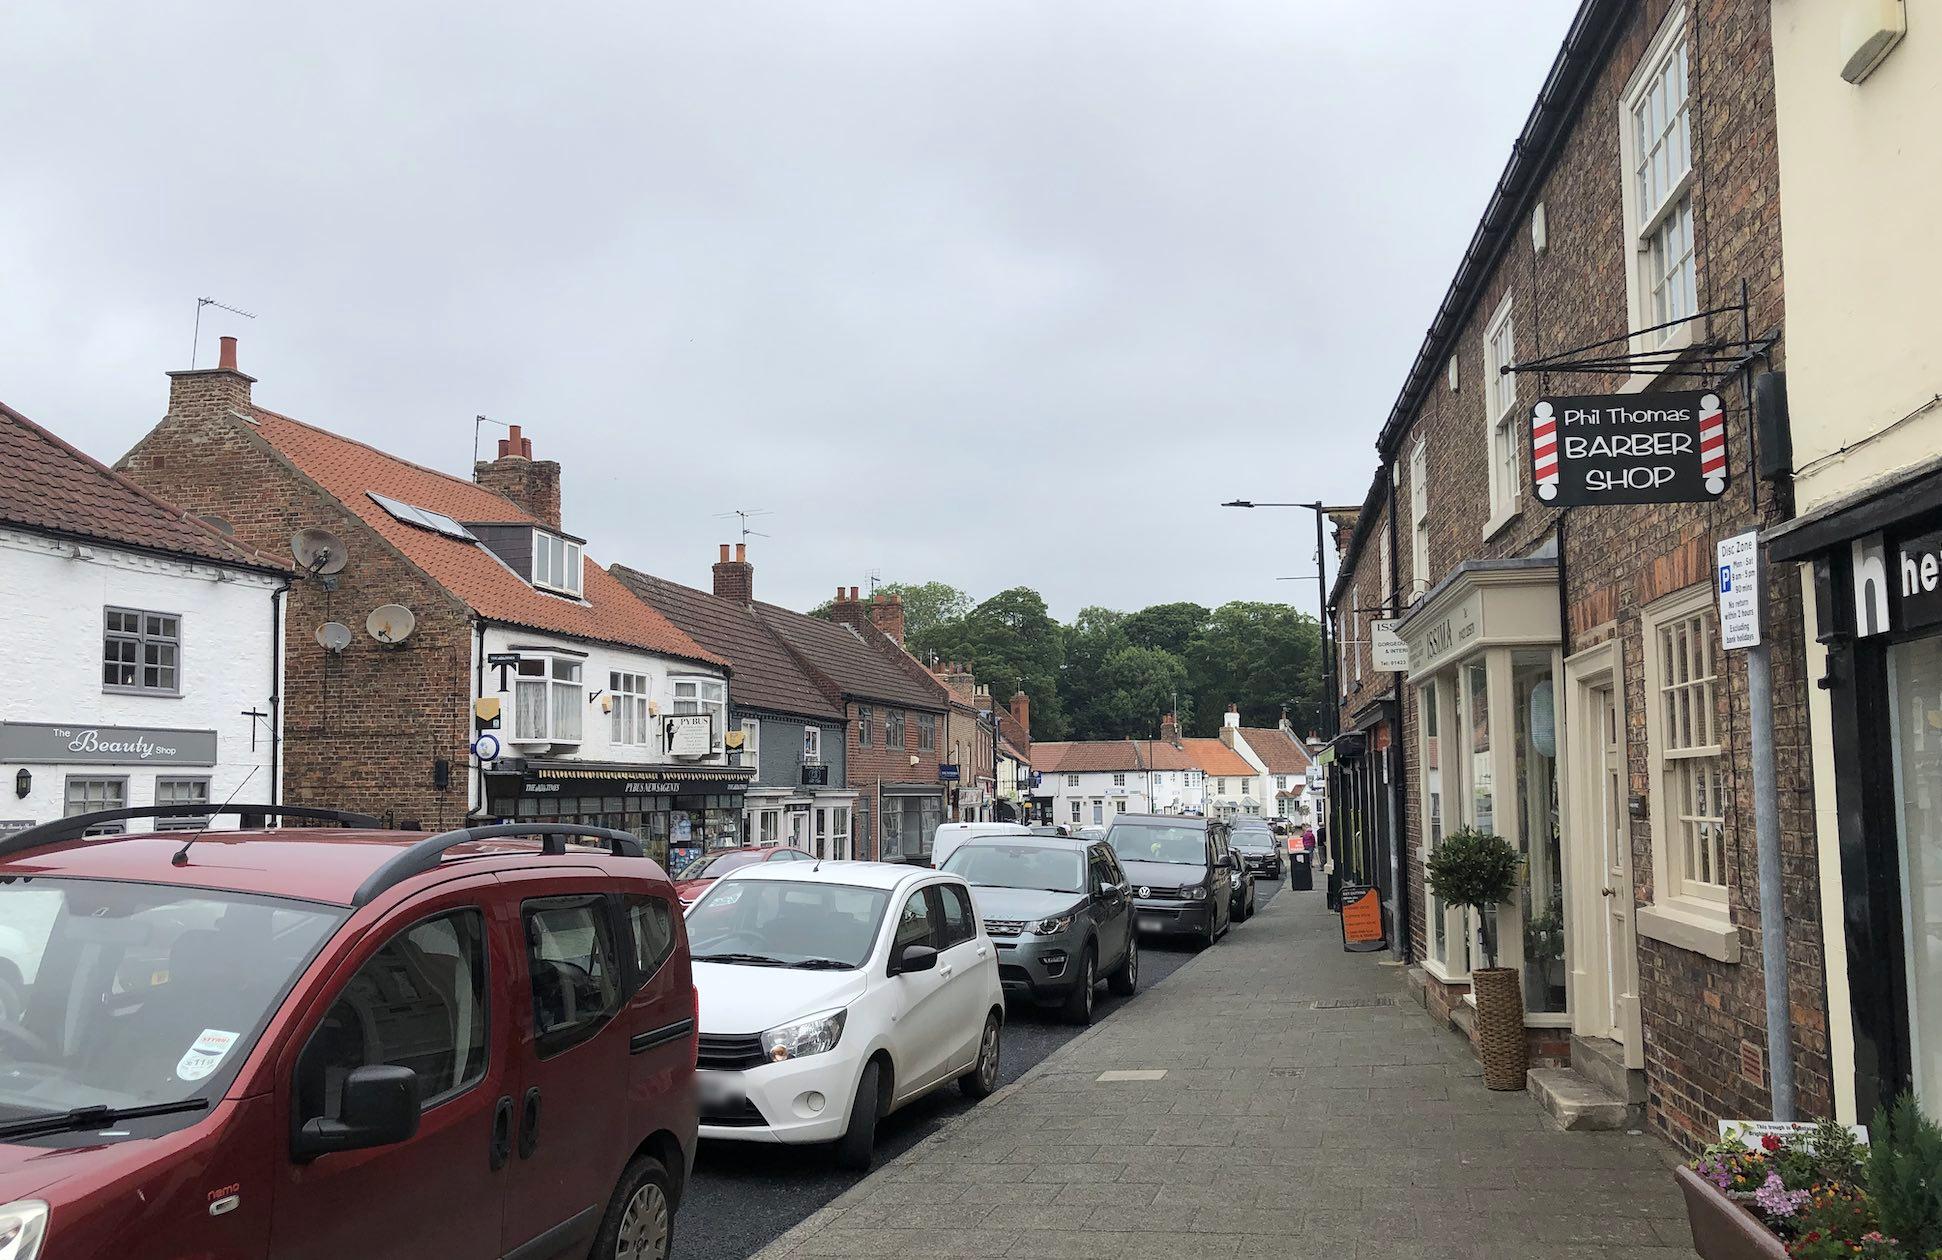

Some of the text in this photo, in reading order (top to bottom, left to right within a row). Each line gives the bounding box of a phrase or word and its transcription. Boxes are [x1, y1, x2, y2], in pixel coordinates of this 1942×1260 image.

[1564, 407, 1691, 427] Phil Thomas
[1565, 432, 1694, 459] BARBER
[1585, 466, 1676, 491] SHOP
[1721, 541, 1753, 557] Disc Zone
[1745, 557, 1754, 566] Sat
[1742, 584, 1753, 592] mins
[1735, 599, 1749, 607] return
[1725, 611, 1737, 620] within
[1741, 609, 1754, 617] hours
[1729, 623, 1750, 632] Excluding
[1726, 633, 1755, 643] bank holidays
[53, 728, 177, 759] The Beauty Shop
[208, 1183, 240, 1200] nemo
